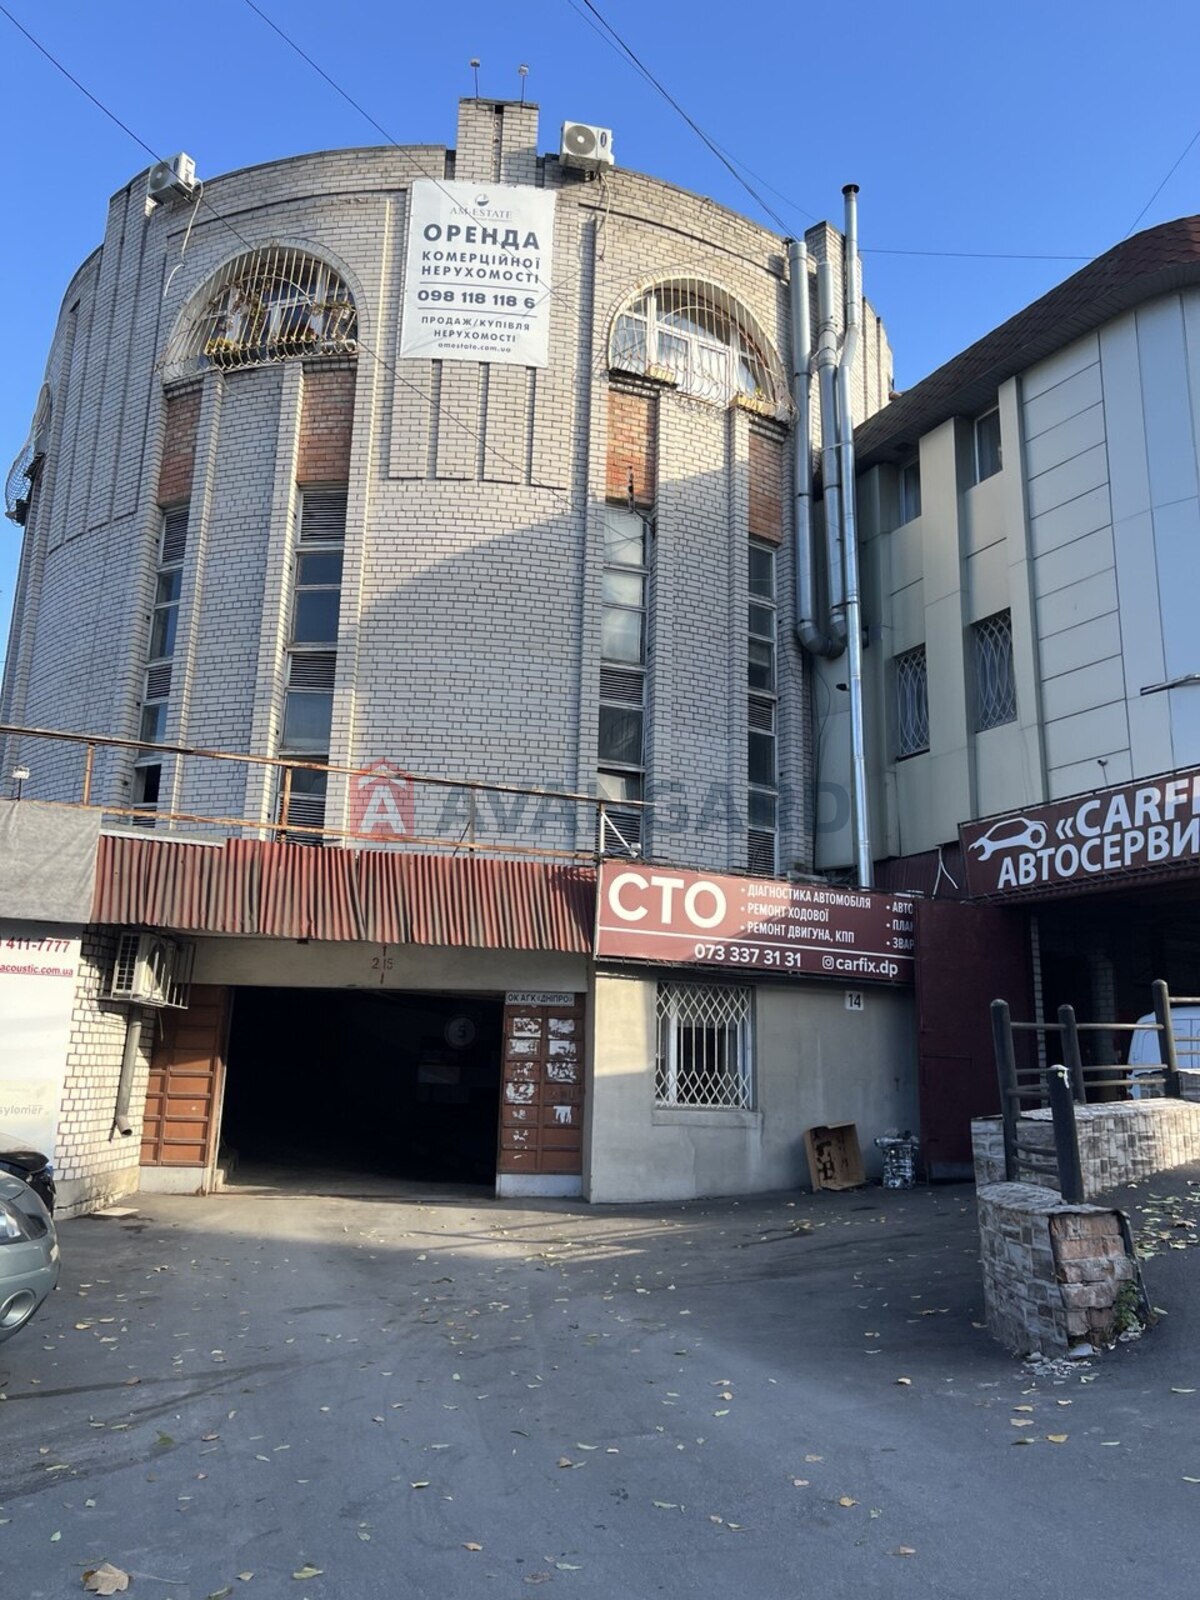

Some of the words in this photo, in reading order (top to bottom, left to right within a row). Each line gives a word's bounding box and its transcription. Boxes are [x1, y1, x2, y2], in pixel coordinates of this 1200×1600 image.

[423, 223, 540, 250] ОРЕНДА
[422, 251, 540, 269] КОМЕРЦІЙНОЇ
[422, 265, 539, 284] НЕРУХОМОСТІ
[418, 290, 454, 301] 098
[461, 292, 486, 304] 118
[493, 294, 517, 306] 118
[524, 297, 535, 309] 6
[421, 316, 530, 331] ПРОДАЖ/КУПІВЛЯ
[434, 330, 516, 342] НЕРУХОМОСТІ
[608, 873, 727, 928] СТО
[747, 884, 811, 900] ДІАГНОСТИКА
[813, 893, 870, 909] АВТОМОБІЛЯ
[747, 903, 787, 918] РЕМОНТ
[788, 907, 829, 922] ХОДОВОЇ
[747, 922, 785, 936] РЕМОНТ
[787, 926, 833, 943] ДВИГУНА,
[835, 930, 854, 943] КПП
[6, 936, 71, 953] 411-7777
[694, 943, 725, 961] 073
[729, 947, 759, 963] 337
[764, 950, 780, 965] 31
[784, 952, 801, 967] 31
[836, 956, 898, 977] carfix.dp
[848, 993, 861, 1008] 14
